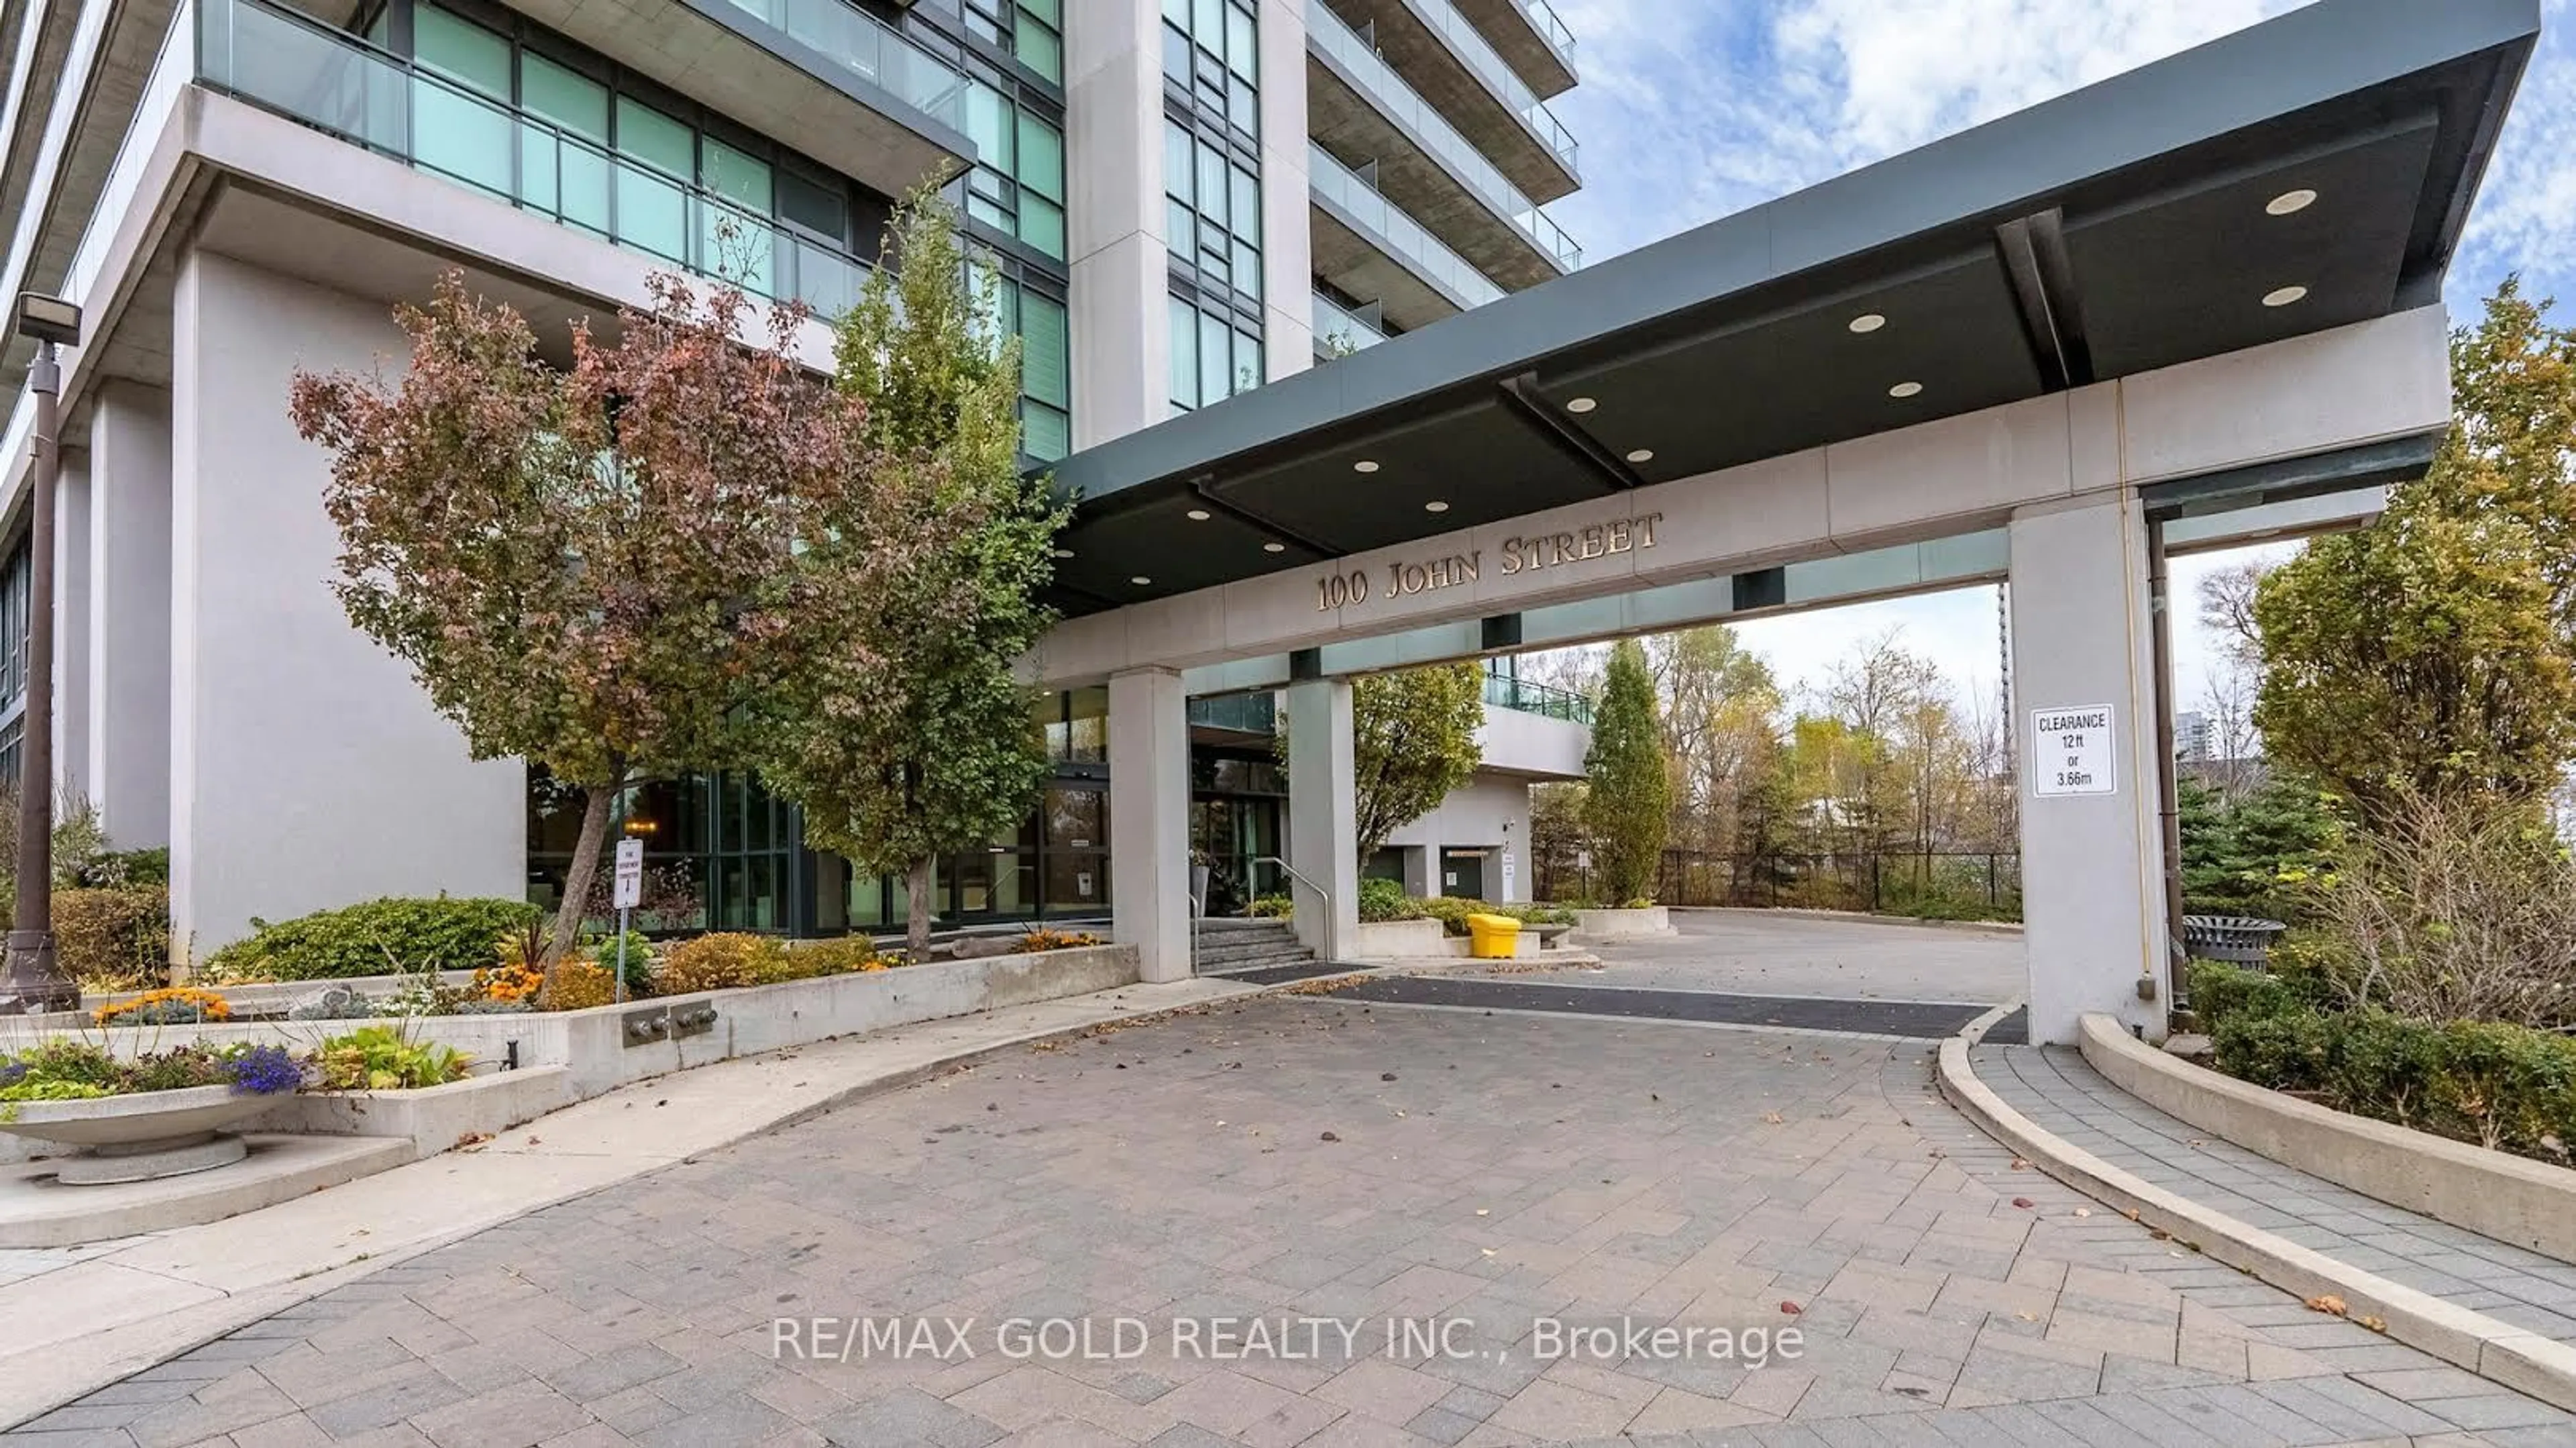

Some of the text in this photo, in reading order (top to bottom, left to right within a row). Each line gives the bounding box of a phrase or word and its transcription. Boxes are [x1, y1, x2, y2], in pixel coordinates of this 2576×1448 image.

[1317, 513, 1662, 611] 100 JOHN STREET
[2040, 713, 2105, 732] CLEARANCE
[2068, 756, 2079, 767] or
[2057, 772, 2092, 786] 3.66m
